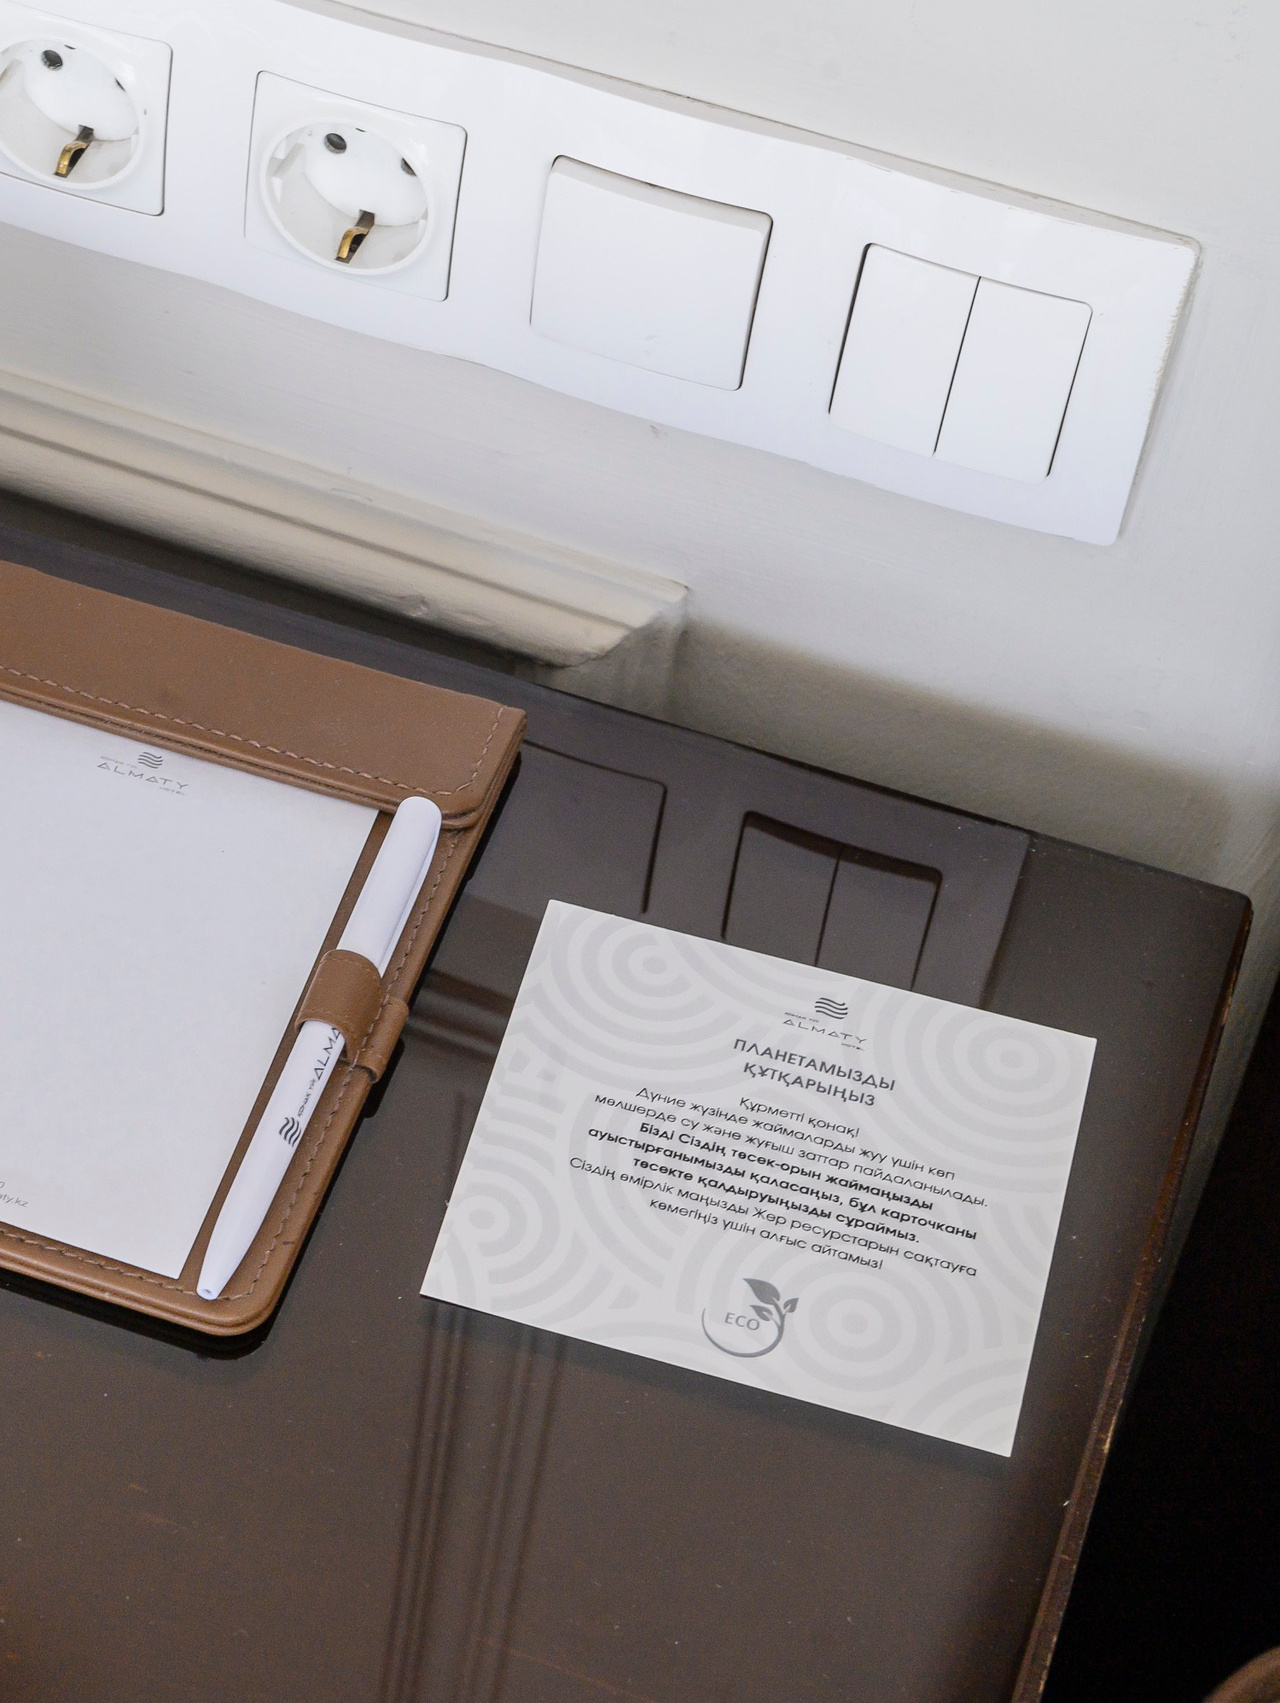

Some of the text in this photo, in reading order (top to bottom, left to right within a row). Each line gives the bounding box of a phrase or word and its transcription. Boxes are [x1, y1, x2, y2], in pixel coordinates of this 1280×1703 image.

[97, 762, 189, 789] ALMATY
[733, 1038, 896, 1091] ПЛАНЕТАМЫЗДЫ
[783, 1018, 868, 1044] ALMATY
[739, 1097, 860, 1138] Құрметті қонақ!
[743, 1062, 875, 1106] ҚҰТҚАРЫҢЫЗ
[594, 1094, 988, 1207] мөлшерде су және жуғыш заттар пайдаланылады.
[635, 1087, 955, 1180] Дүние жүзінде жаймаларды жуу үшін көп
[639, 1122, 933, 1210] Бізді Сіздің төсек-орын жаймаңызды
[569, 1157, 977, 1277] Сіздің өмірлік маңызды Жер ресурстарын сақтауға
[588, 1128, 977, 1240] ауыстырғанымызды қаласаңыз, бұл карточканы
[633, 1158, 920, 1243] төсекте қалдыруыңызды сұраймыз.
[649, 1199, 884, 1270] көмегіңіз үшін алғыс айтамыз!
[724, 1312, 760, 1331] ECO
